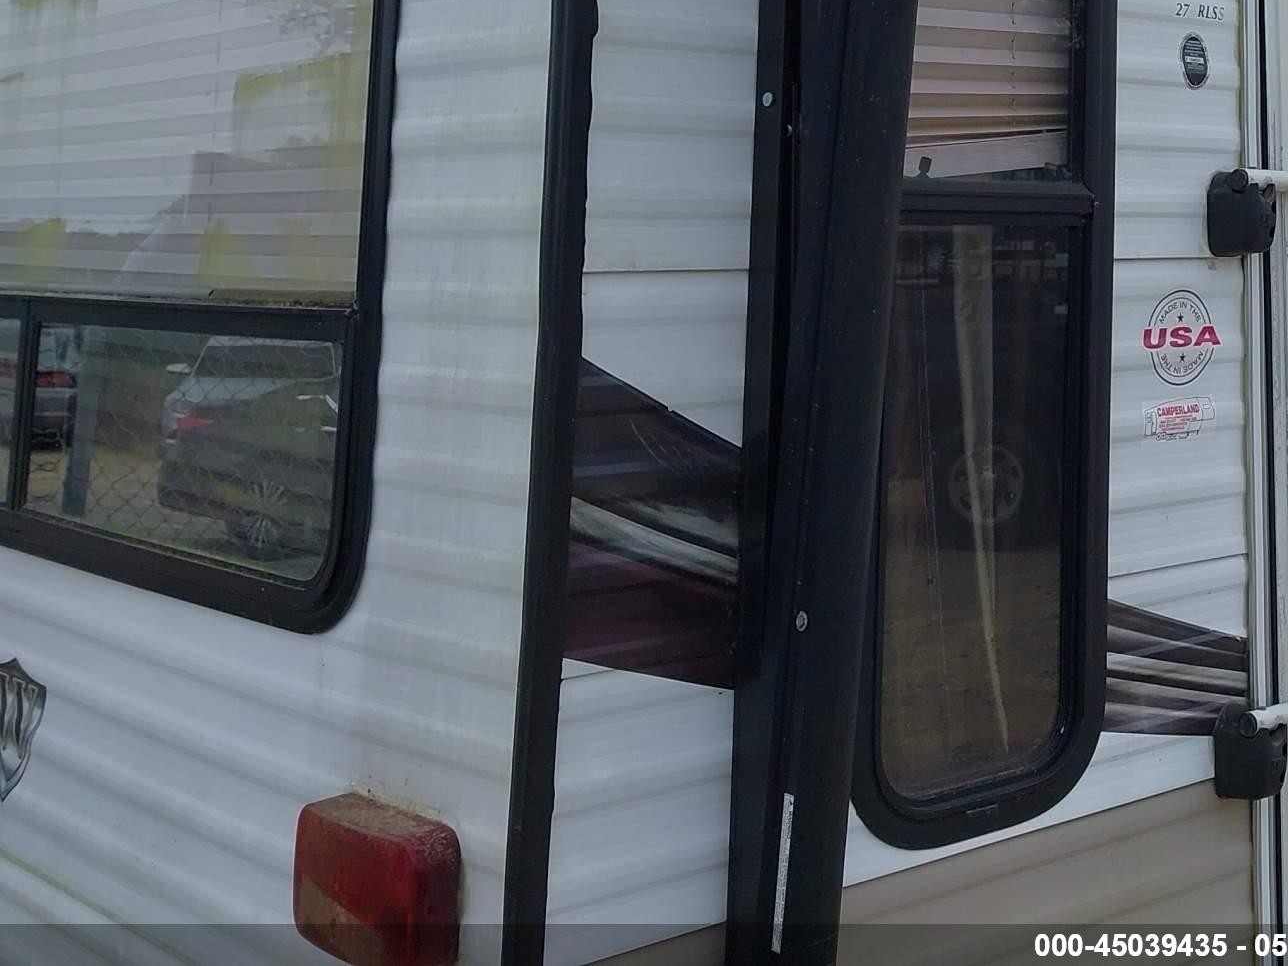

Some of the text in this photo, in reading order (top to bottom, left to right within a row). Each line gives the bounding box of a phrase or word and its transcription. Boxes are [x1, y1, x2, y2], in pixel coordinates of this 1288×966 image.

[1176, 2, 1225, 21] 27 RLSS
[1159, 301, 1202, 324] MADE IN THE
[1142, 325, 1222, 350] USA
[1161, 350, 1204, 375] MADE IN THE
[1156, 403, 1200, 417] CAMPERLAND
